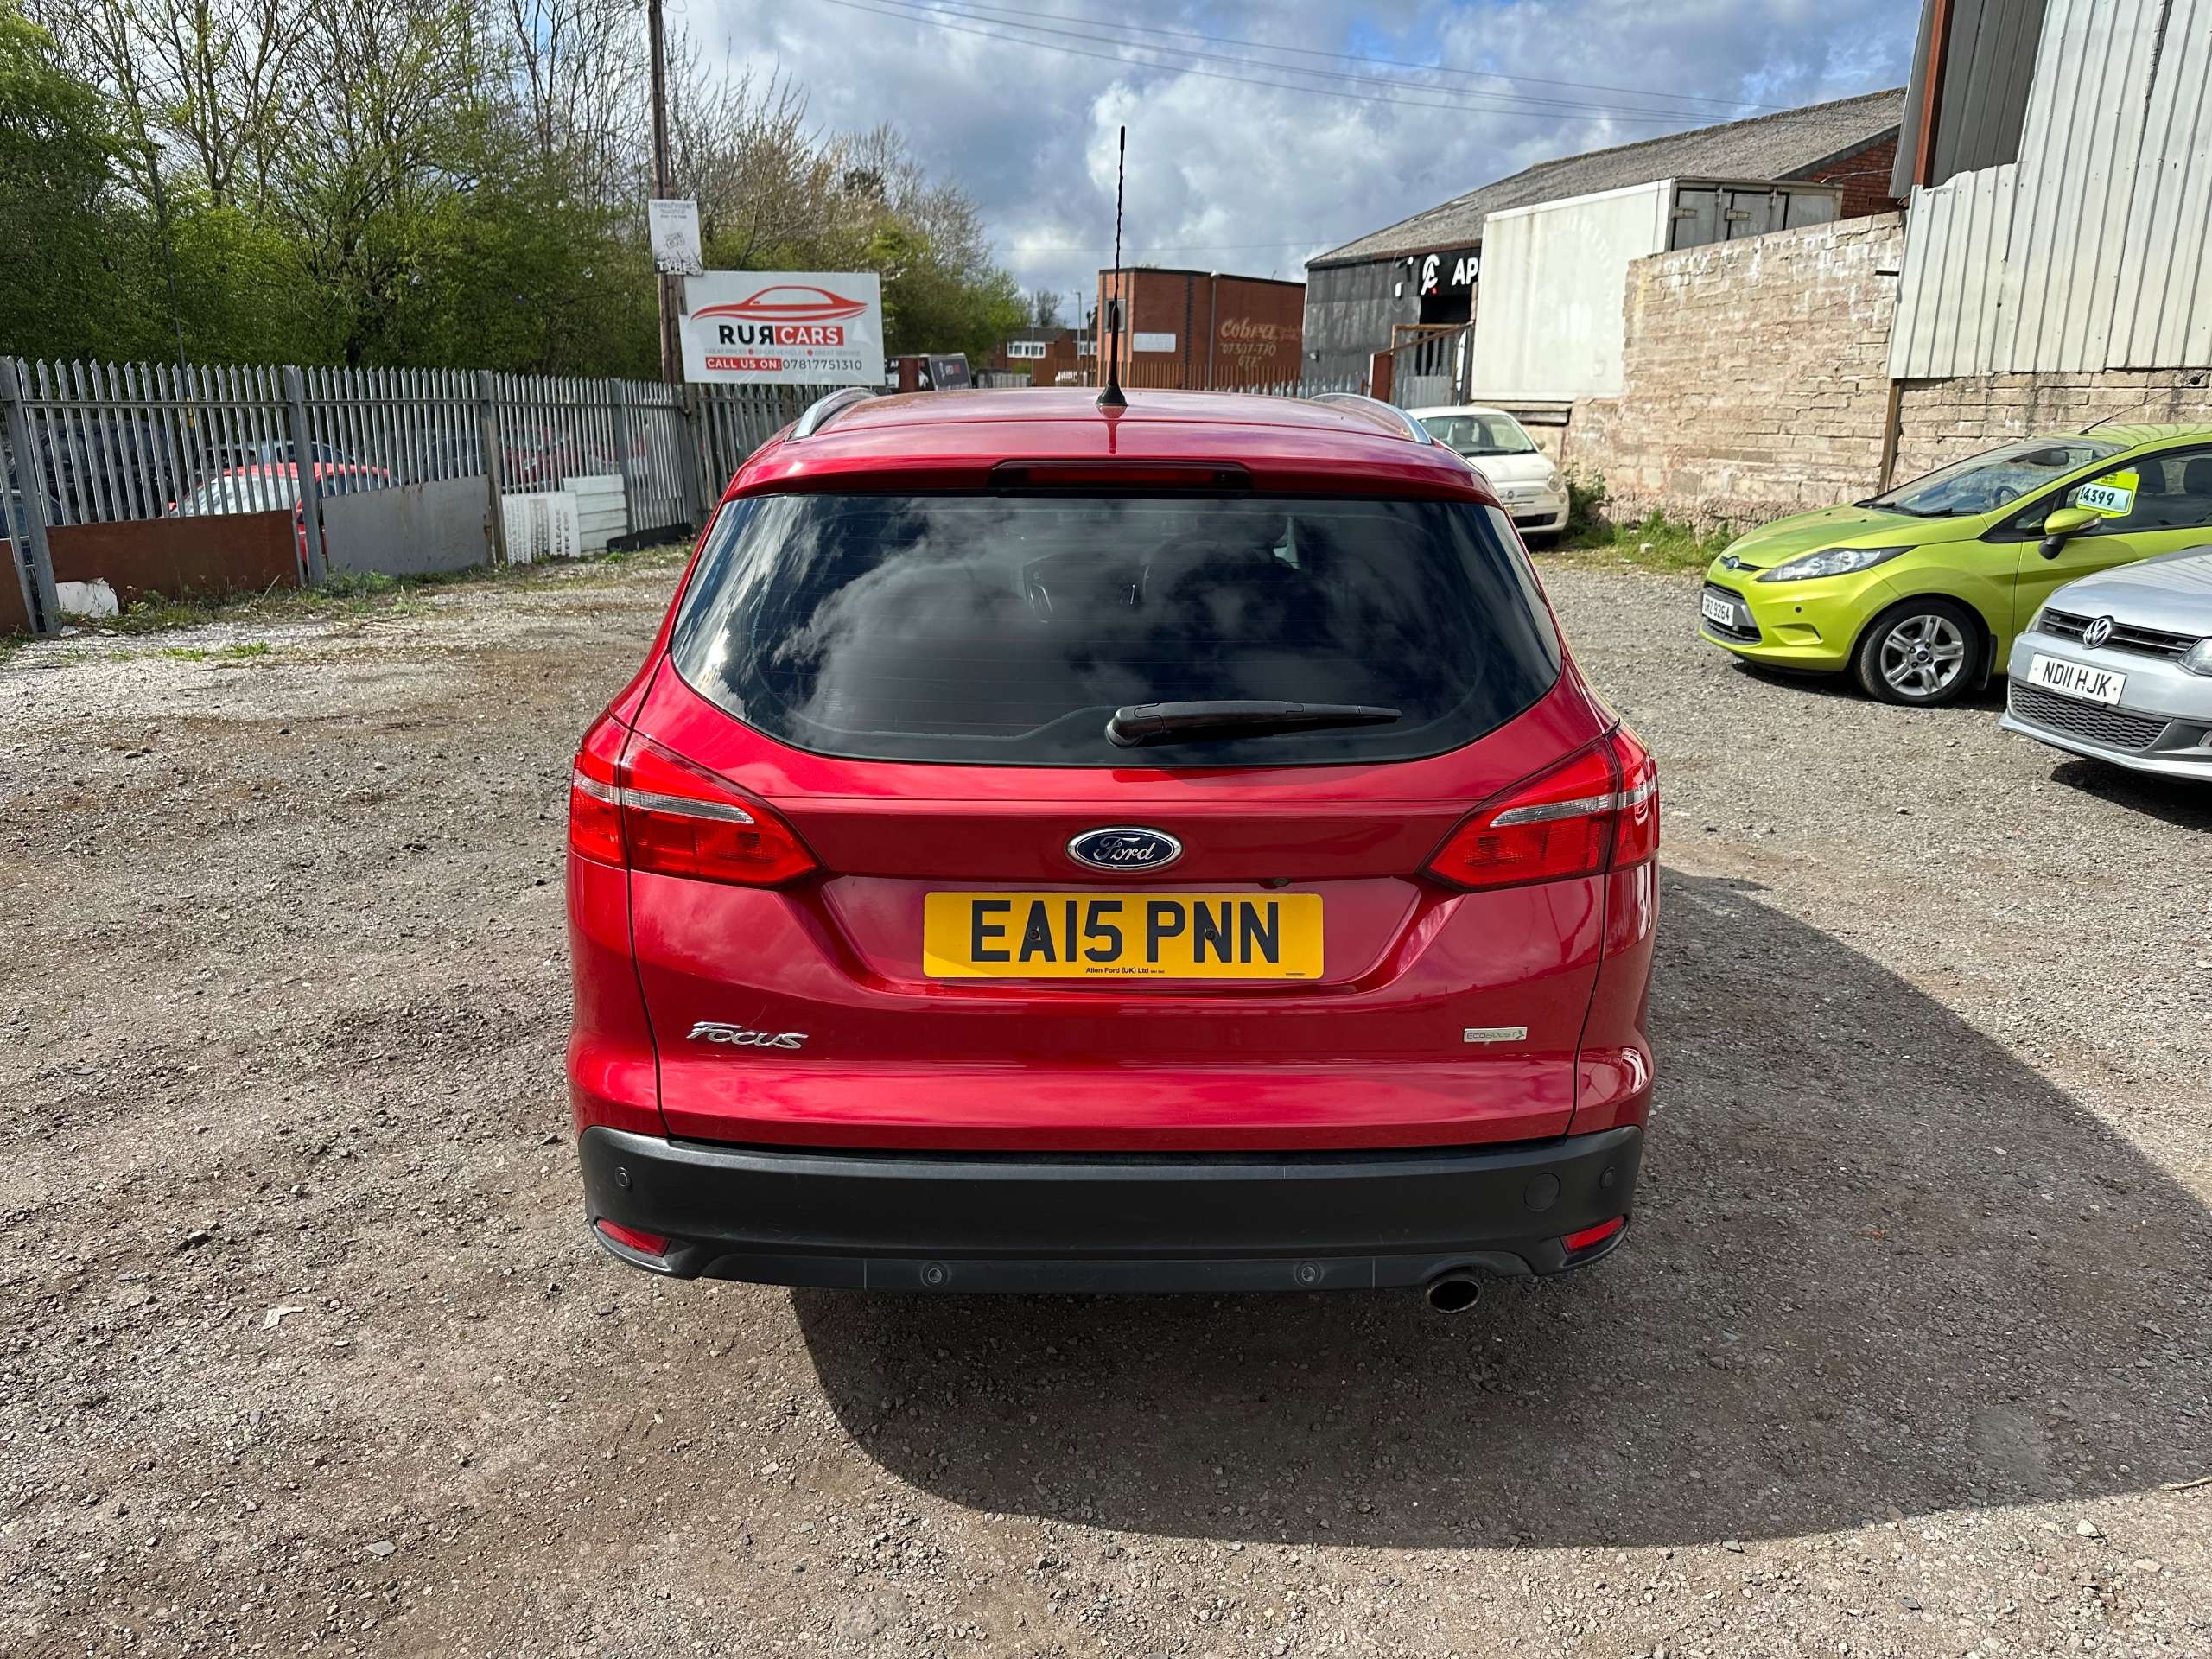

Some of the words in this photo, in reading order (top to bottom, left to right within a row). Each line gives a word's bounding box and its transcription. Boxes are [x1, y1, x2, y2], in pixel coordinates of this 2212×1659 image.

[780, 327, 839, 344] CARS
[1220, 318, 1274, 340] Cobra
[707, 359, 737, 368] CALL
[741, 359, 756, 369] US
[760, 359, 781, 370] ON:
[783, 359, 862, 371] 07817751310
[2042, 661, 2074, 688] ND11
[2075, 669, 2112, 697] HJK
[1093, 836, 1156, 861] Ford
[971, 899, 1122, 963] EA15
[1147, 900, 1279, 963] PNN
